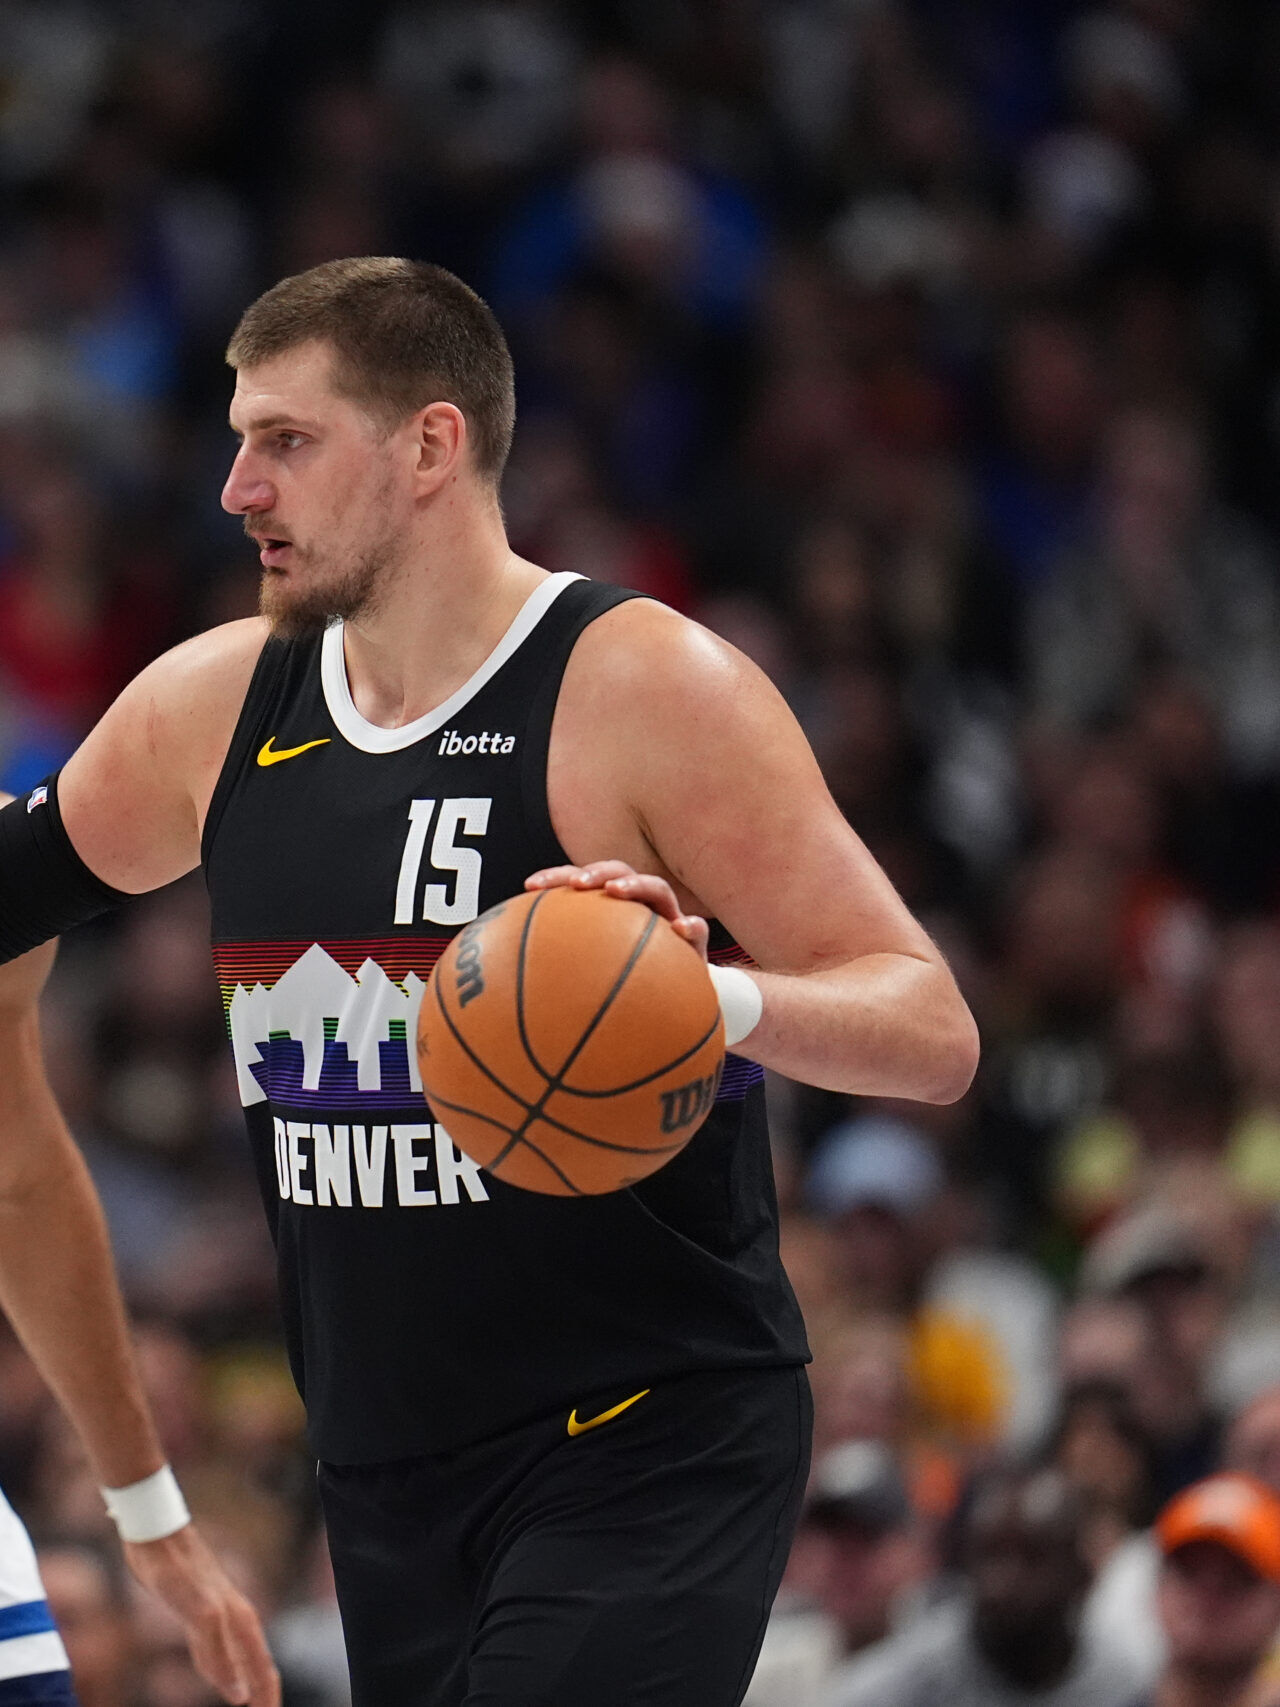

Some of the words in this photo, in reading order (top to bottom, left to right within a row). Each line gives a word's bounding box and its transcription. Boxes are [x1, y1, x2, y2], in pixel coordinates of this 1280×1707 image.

[438, 730, 516, 756] ibotta
[394, 797, 492, 925] 15
[273, 1116, 490, 1208] DENVER
